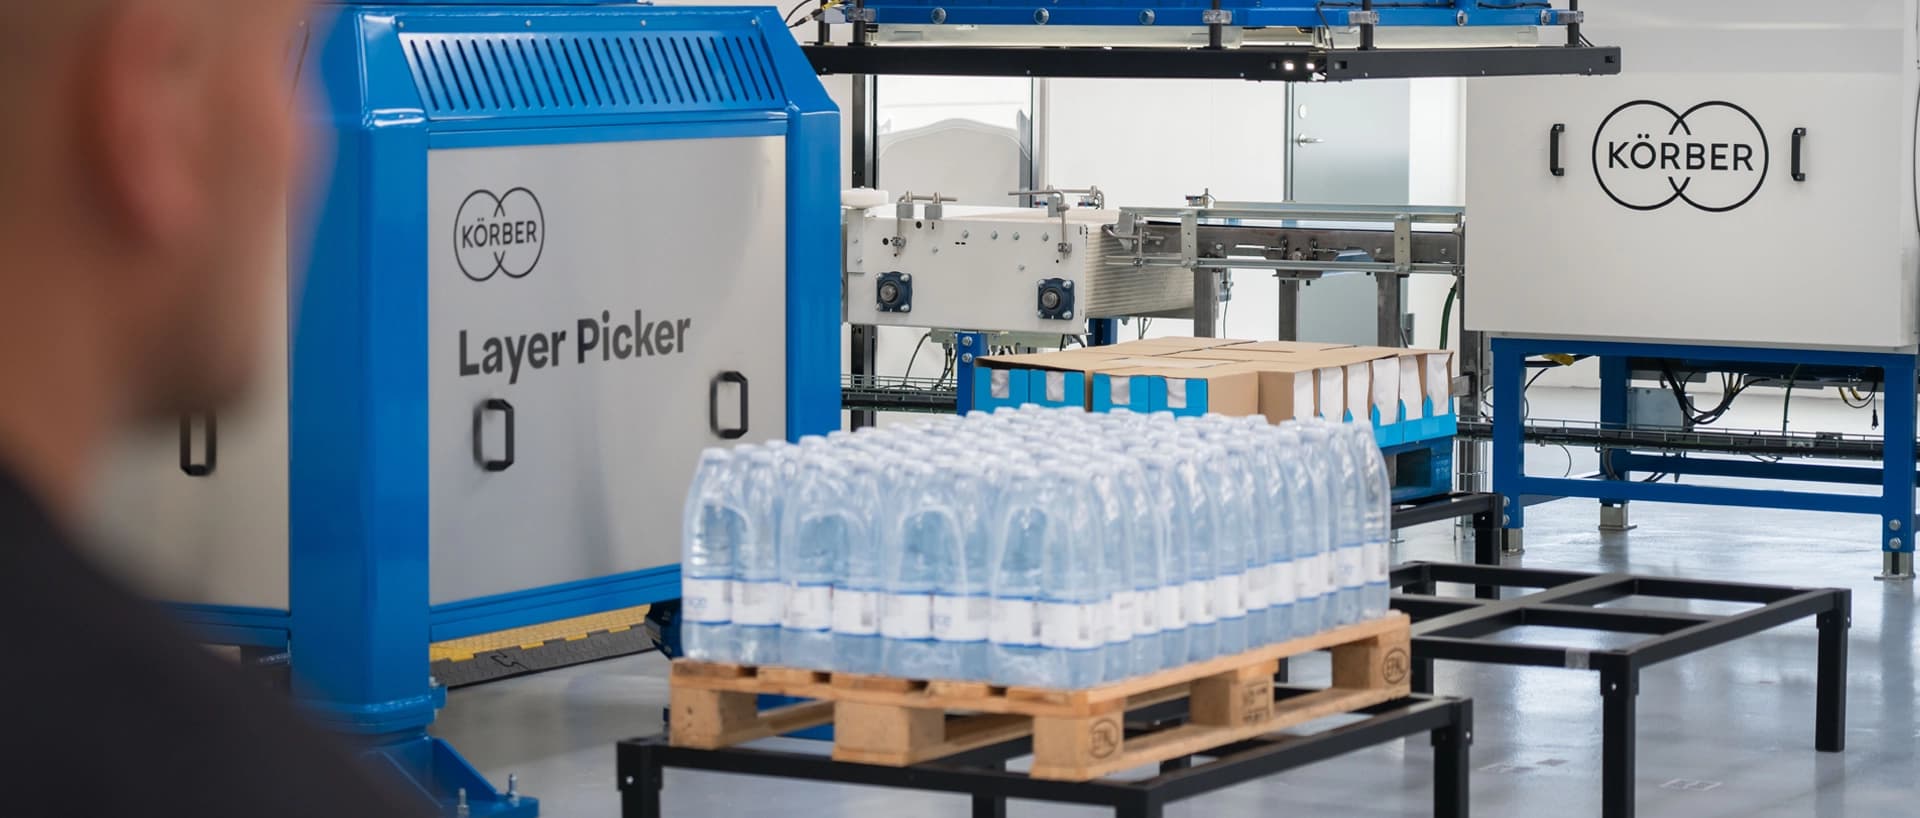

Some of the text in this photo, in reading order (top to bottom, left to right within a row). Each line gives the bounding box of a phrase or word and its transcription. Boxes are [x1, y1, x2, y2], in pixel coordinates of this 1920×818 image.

[1608, 133, 1754, 171] KÖRBER
[461, 217, 538, 249] KÖRBER
[458, 309, 691, 385] Layer Picker
